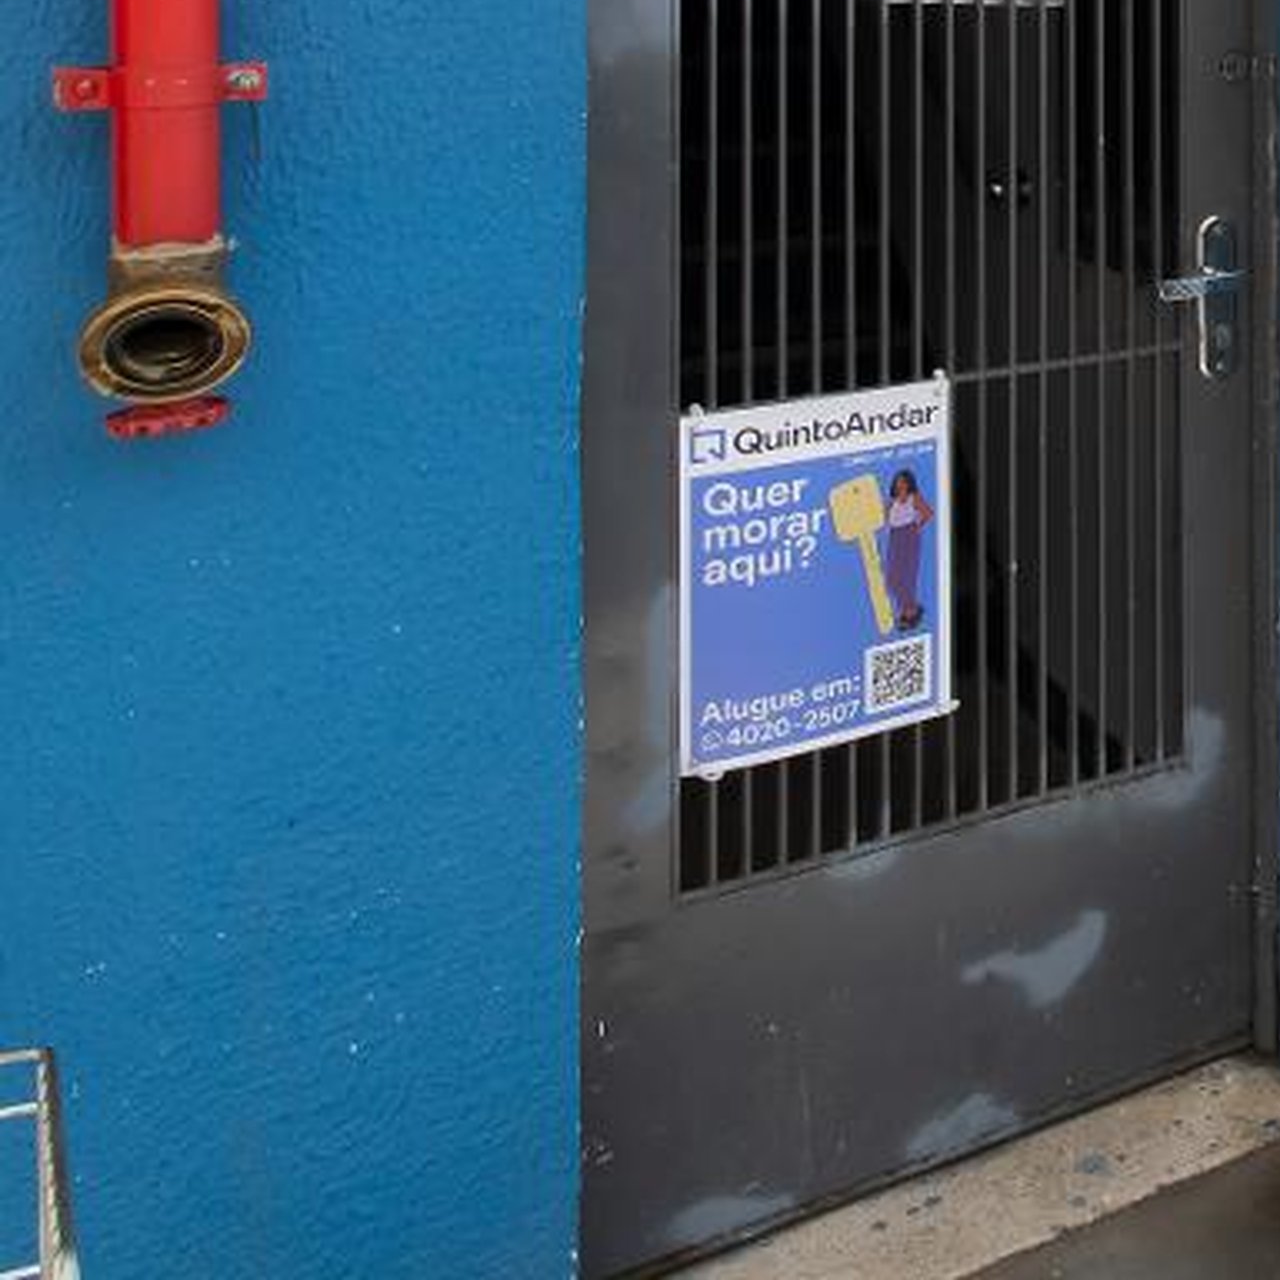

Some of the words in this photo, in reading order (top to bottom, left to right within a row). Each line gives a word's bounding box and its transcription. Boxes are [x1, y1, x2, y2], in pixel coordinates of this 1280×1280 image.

[734, 403, 938, 455] QuintoAndar
[704, 478, 807, 516] Quer
[704, 508, 826, 551] morar
[704, 536, 816, 586] aqui?
[702, 688, 803, 724] Alugue
[809, 675, 861, 700] em:
